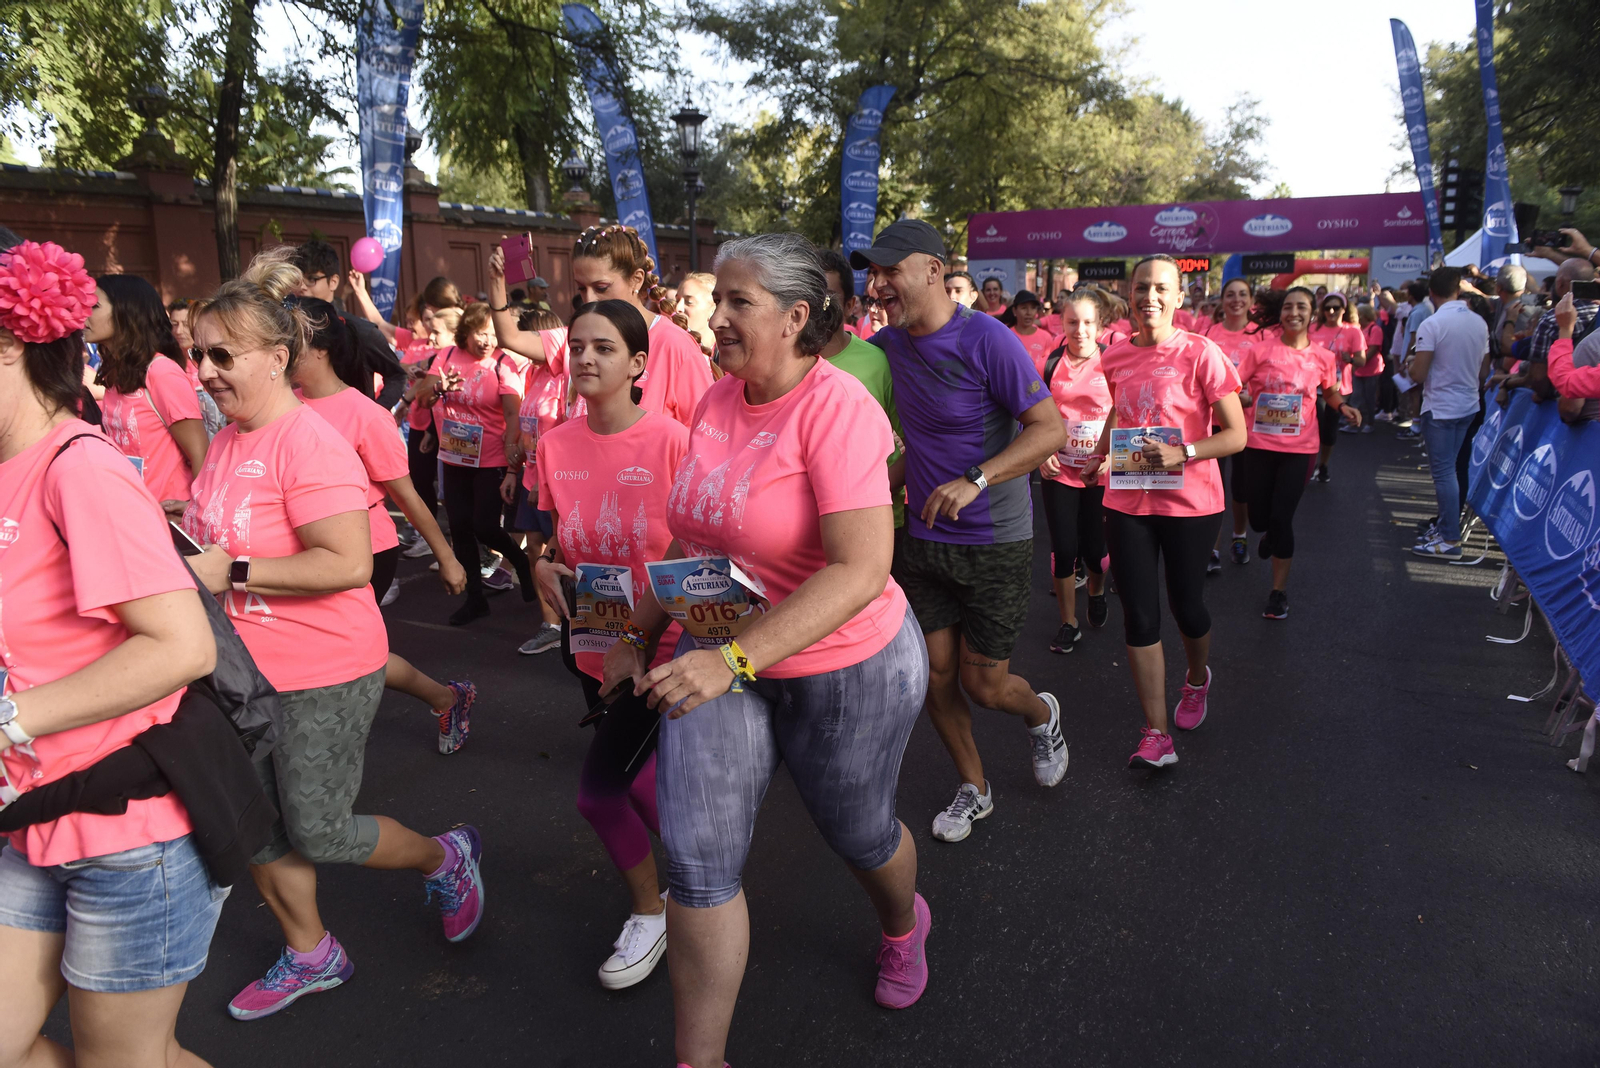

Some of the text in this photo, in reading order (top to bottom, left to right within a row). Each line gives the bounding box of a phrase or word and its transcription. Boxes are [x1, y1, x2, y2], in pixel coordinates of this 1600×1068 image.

[1248, 222, 1290, 233] ASTURIANA
[1316, 218, 1359, 230] OYSHO
[1383, 218, 1424, 228] Santander
[1027, 230, 1062, 241] OYSHO
[1085, 226, 1125, 238] ASTURIANA
[1150, 225, 1187, 237] Carrera
[976, 235, 1008, 244] Santander
[1249, 259, 1288, 270] OYSHO
[1084, 266, 1120, 277] OYSHO
[1267, 410, 1287, 418] 016
[450, 437, 467, 448] 016
[1071, 439, 1093, 449] 016
[554, 470, 590, 481] OYSHO
[620, 473, 651, 482] ASTURIANA
[1516, 462, 1549, 509] ASTURIANA
[1548, 491, 1585, 549] ASTURIANA
[686, 580, 730, 592] ASTURIANA
[595, 601, 630, 620] 016
[690, 602, 737, 623] 016
[605, 621, 624, 630] 4978
[707, 626, 731, 635] 4979
[589, 628, 610, 637] CARRERA
[578, 639, 608, 648] OYSHO
[716, 637, 725, 645] DE
